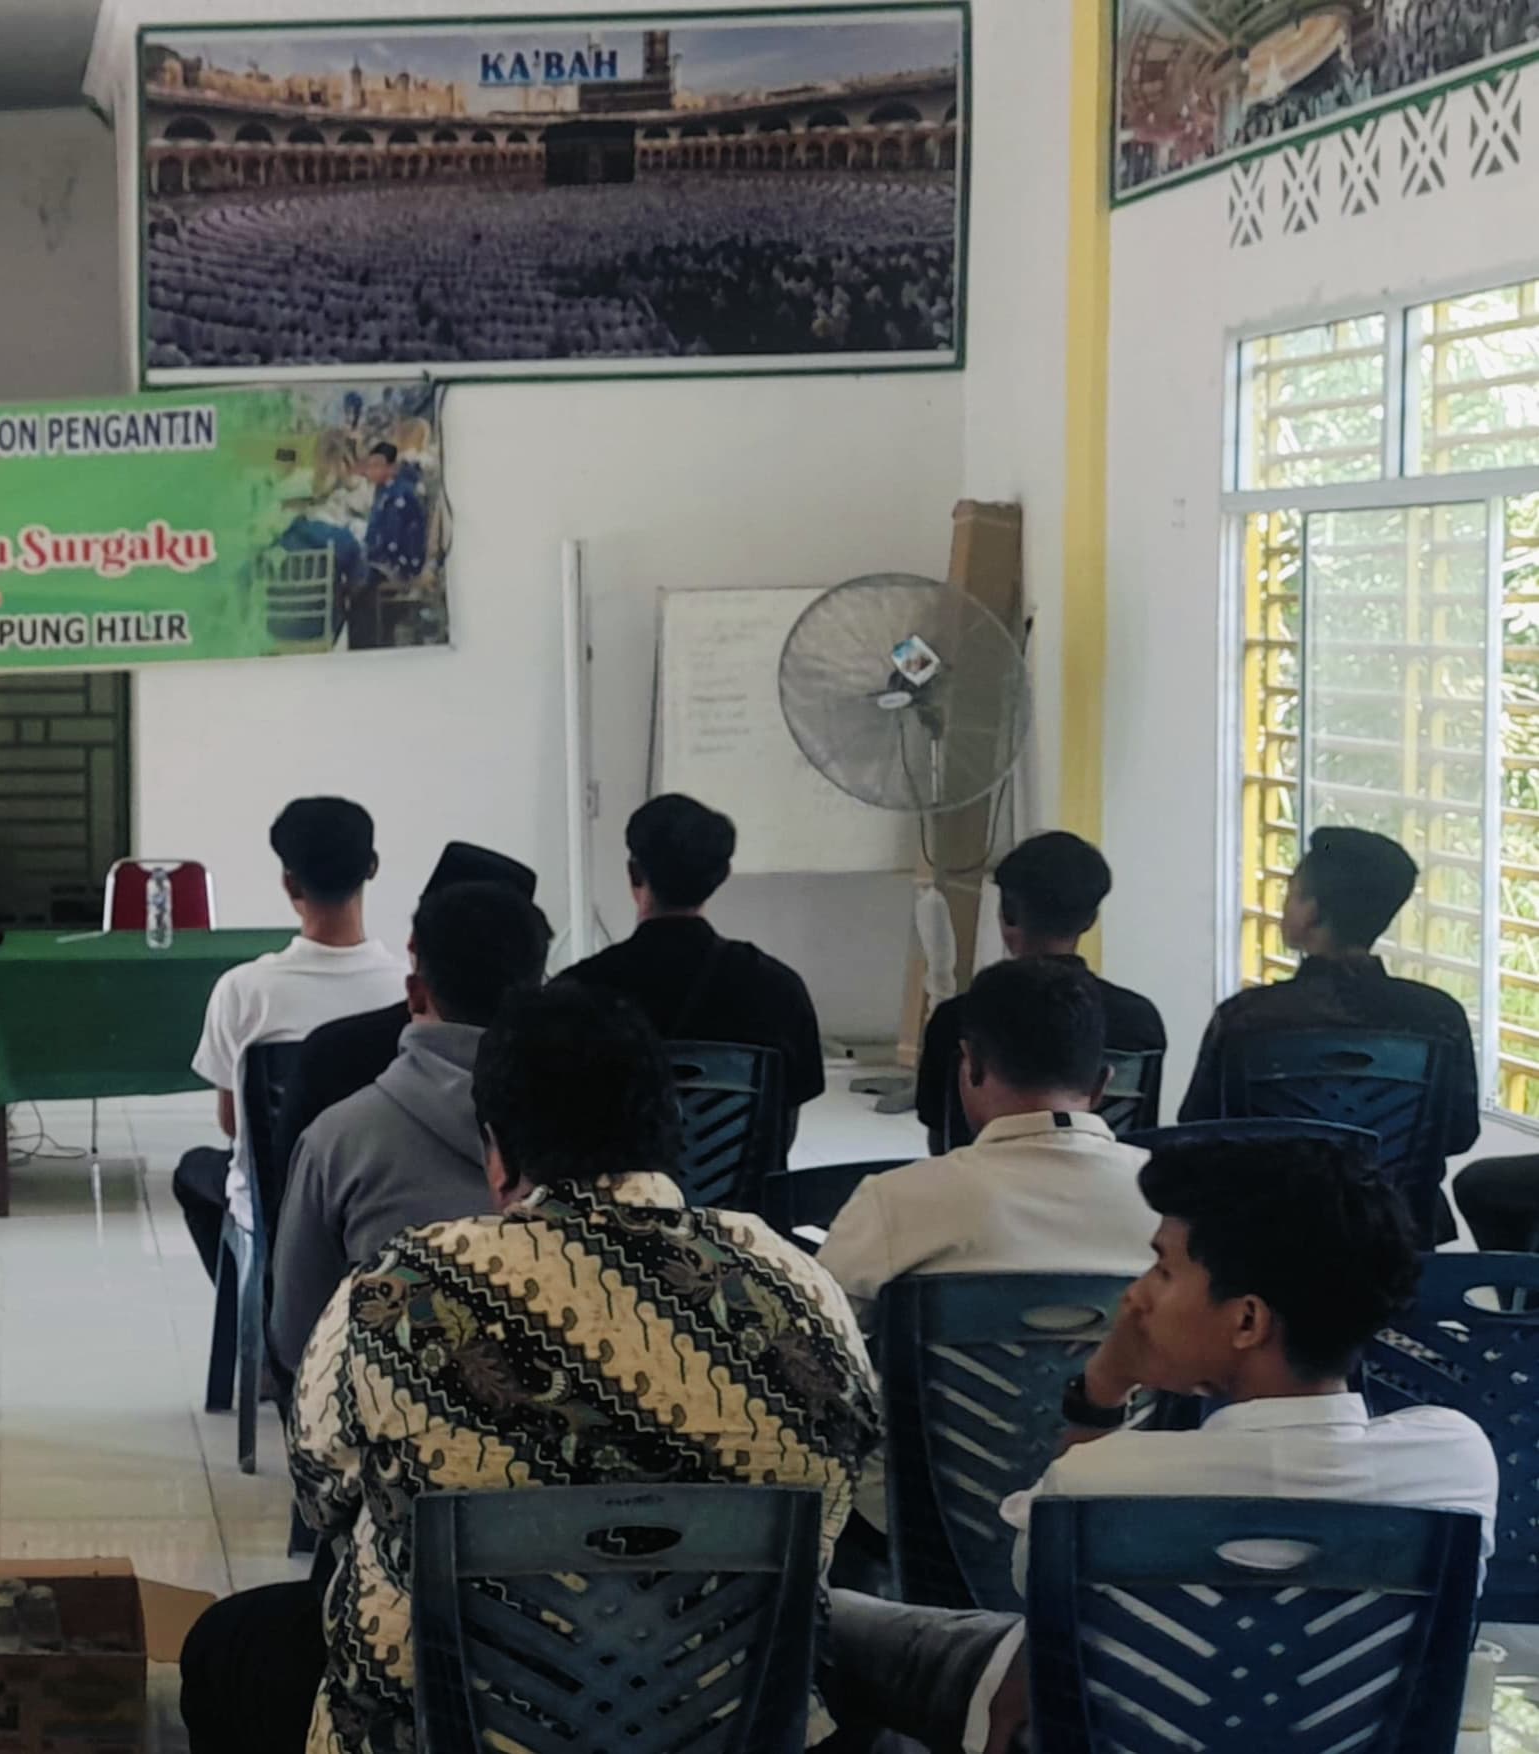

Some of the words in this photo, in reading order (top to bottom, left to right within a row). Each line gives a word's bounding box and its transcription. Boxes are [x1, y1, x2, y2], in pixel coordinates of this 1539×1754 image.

[480, 49, 618, 82] KA'BAH
[47, 410, 214, 450] PENGANTIN
[22, 524, 211, 571] Surgaku
[96, 613, 188, 643] HILIR
